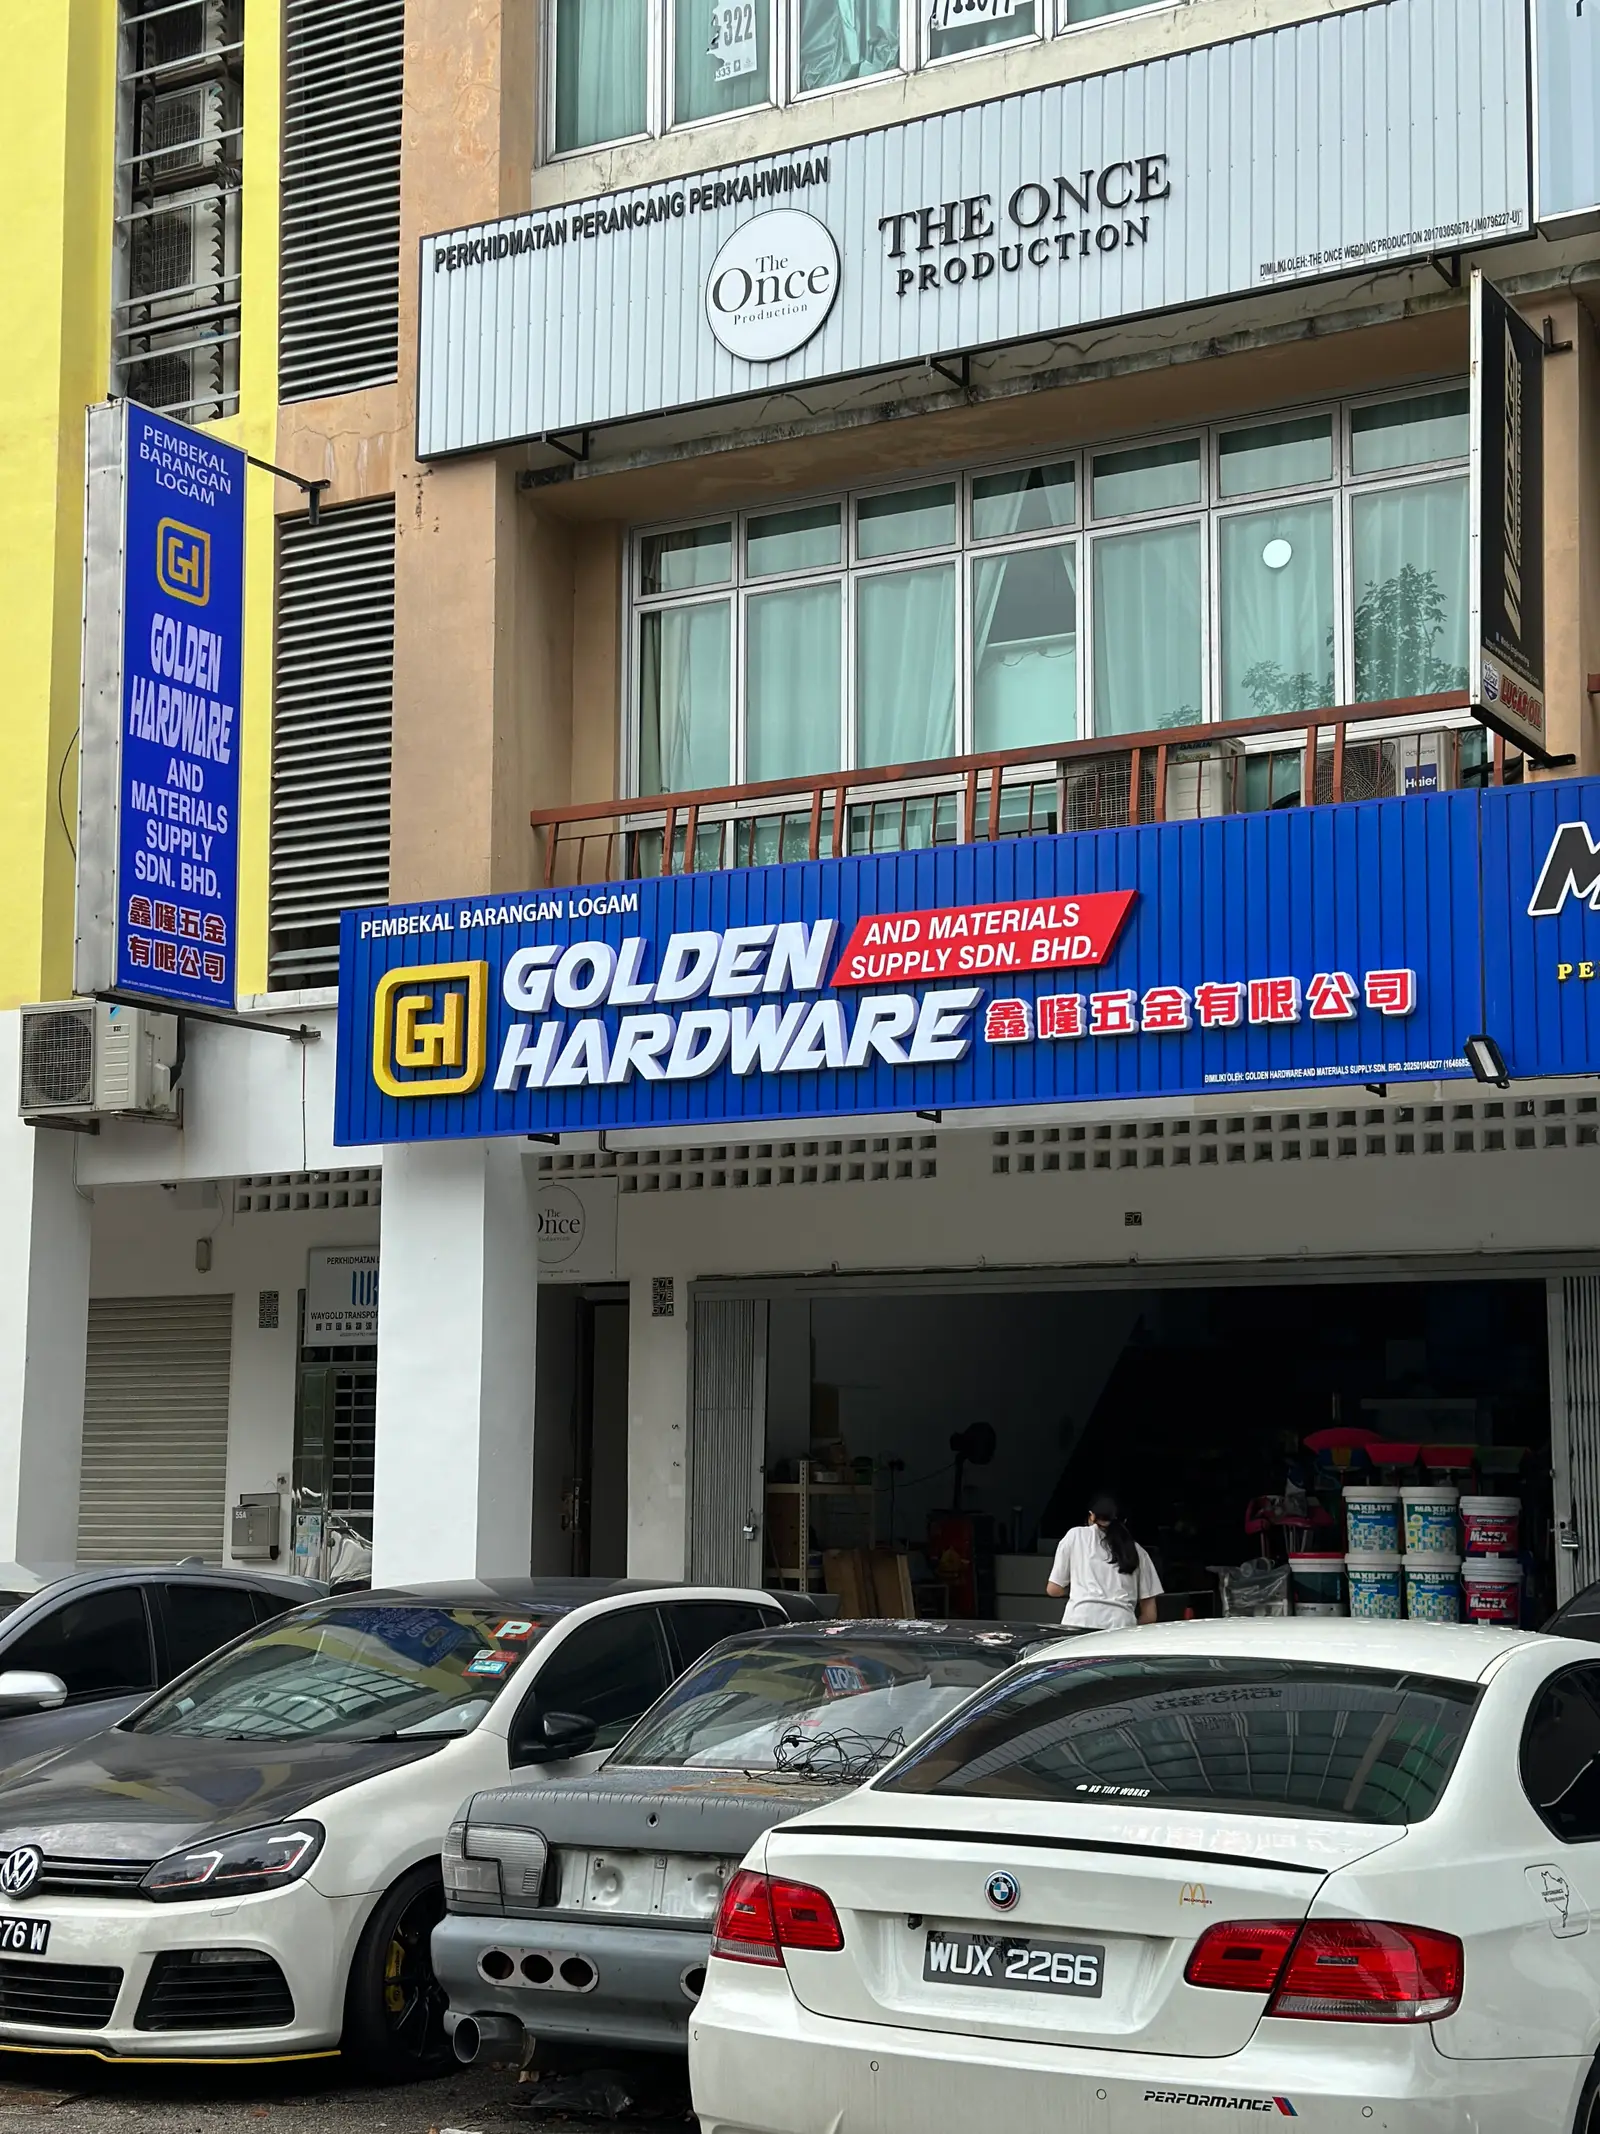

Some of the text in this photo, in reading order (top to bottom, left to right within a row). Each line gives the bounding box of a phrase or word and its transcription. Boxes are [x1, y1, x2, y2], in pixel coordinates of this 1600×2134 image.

[435, 156, 828, 273] PERKHIDMATAN PERANCANG PERKAHWINAN
[878, 153, 1171, 258] THE ONCE
[756, 255, 788, 273] The
[896, 216, 1149, 296] PRODUCTION
[1260, 261, 1286, 277] DIMILIKI
[1287, 256, 1307, 271] OLEH:
[1309, 252, 1322, 266] THE
[1324, 247, 1343, 263] ONCE
[1344, 240, 1377, 258] WEDDING
[1378, 232, 1422, 251] PRODUCTION
[712, 266, 829, 312] Once
[734, 303, 808, 325] Production
[140, 442, 231, 495] BARANGAN
[143, 425, 229, 476] PEMBEKAL
[156, 469, 215, 507] LOGAM
[151, 613, 222, 693] GOLDEN
[129, 675, 234, 764] HARDWARE
[1500, 674, 1528, 720] LUCAS
[1528, 697, 1543, 732] OIL
[167, 758, 204, 793] AND
[131, 780, 228, 835] MATERIALS
[146, 819, 213, 863] SUPPLY
[135, 850, 221, 899] SDN. BHD.
[128, 894, 227, 946] 鑫隆五金
[360, 893, 639, 940] PEMBEKAL BARANGAN LOGAM
[863, 903, 1080, 947] AND MATERIALS
[128, 934, 226, 985] 有限公司
[502, 918, 839, 1013] GOLDEN
[850, 935, 1098, 980] SUPPLY SDN. BHD.
[984, 968, 1417, 1044] 鑫隆五金有限公司
[493, 987, 985, 1091] HARDWARE
[1245, 1070, 1269, 1080] GOLDEN
[1269, 1068, 1302, 1079] HARDWARE
[1302, 1067, 1315, 1077] AND
[1316, 1065, 1349, 1076] MATERIALS
[1350, 1064, 1372, 1074] SUPPLY
[1373, 1063, 1387, 1073] SDN.
[1388, 1062, 1402, 1072] BHD.
[545, 1208, 561, 1218] The
[326, 1256, 376, 1265] PERKHIDMATAN
[311, 1311, 344, 1320] WAYGOLD
[1348, 1503, 1392, 1512] MAXILITE
[1470, 1530, 1508, 1542] MATEX
[1349, 1572, 1393, 1580] MAXILITE
[1409, 1573, 1455, 1581] MAXILITE
[1470, 1597, 1508, 1609] MATEX
[495, 1621, 532, 1637] P
[1119, 1787, 1150, 1797] WORKS
[0, 1920, 47, 1951] 76 W
[930, 1941, 1098, 1987] WUX 2266
[1144, 2091, 1273, 2112] PERFORMANCE
